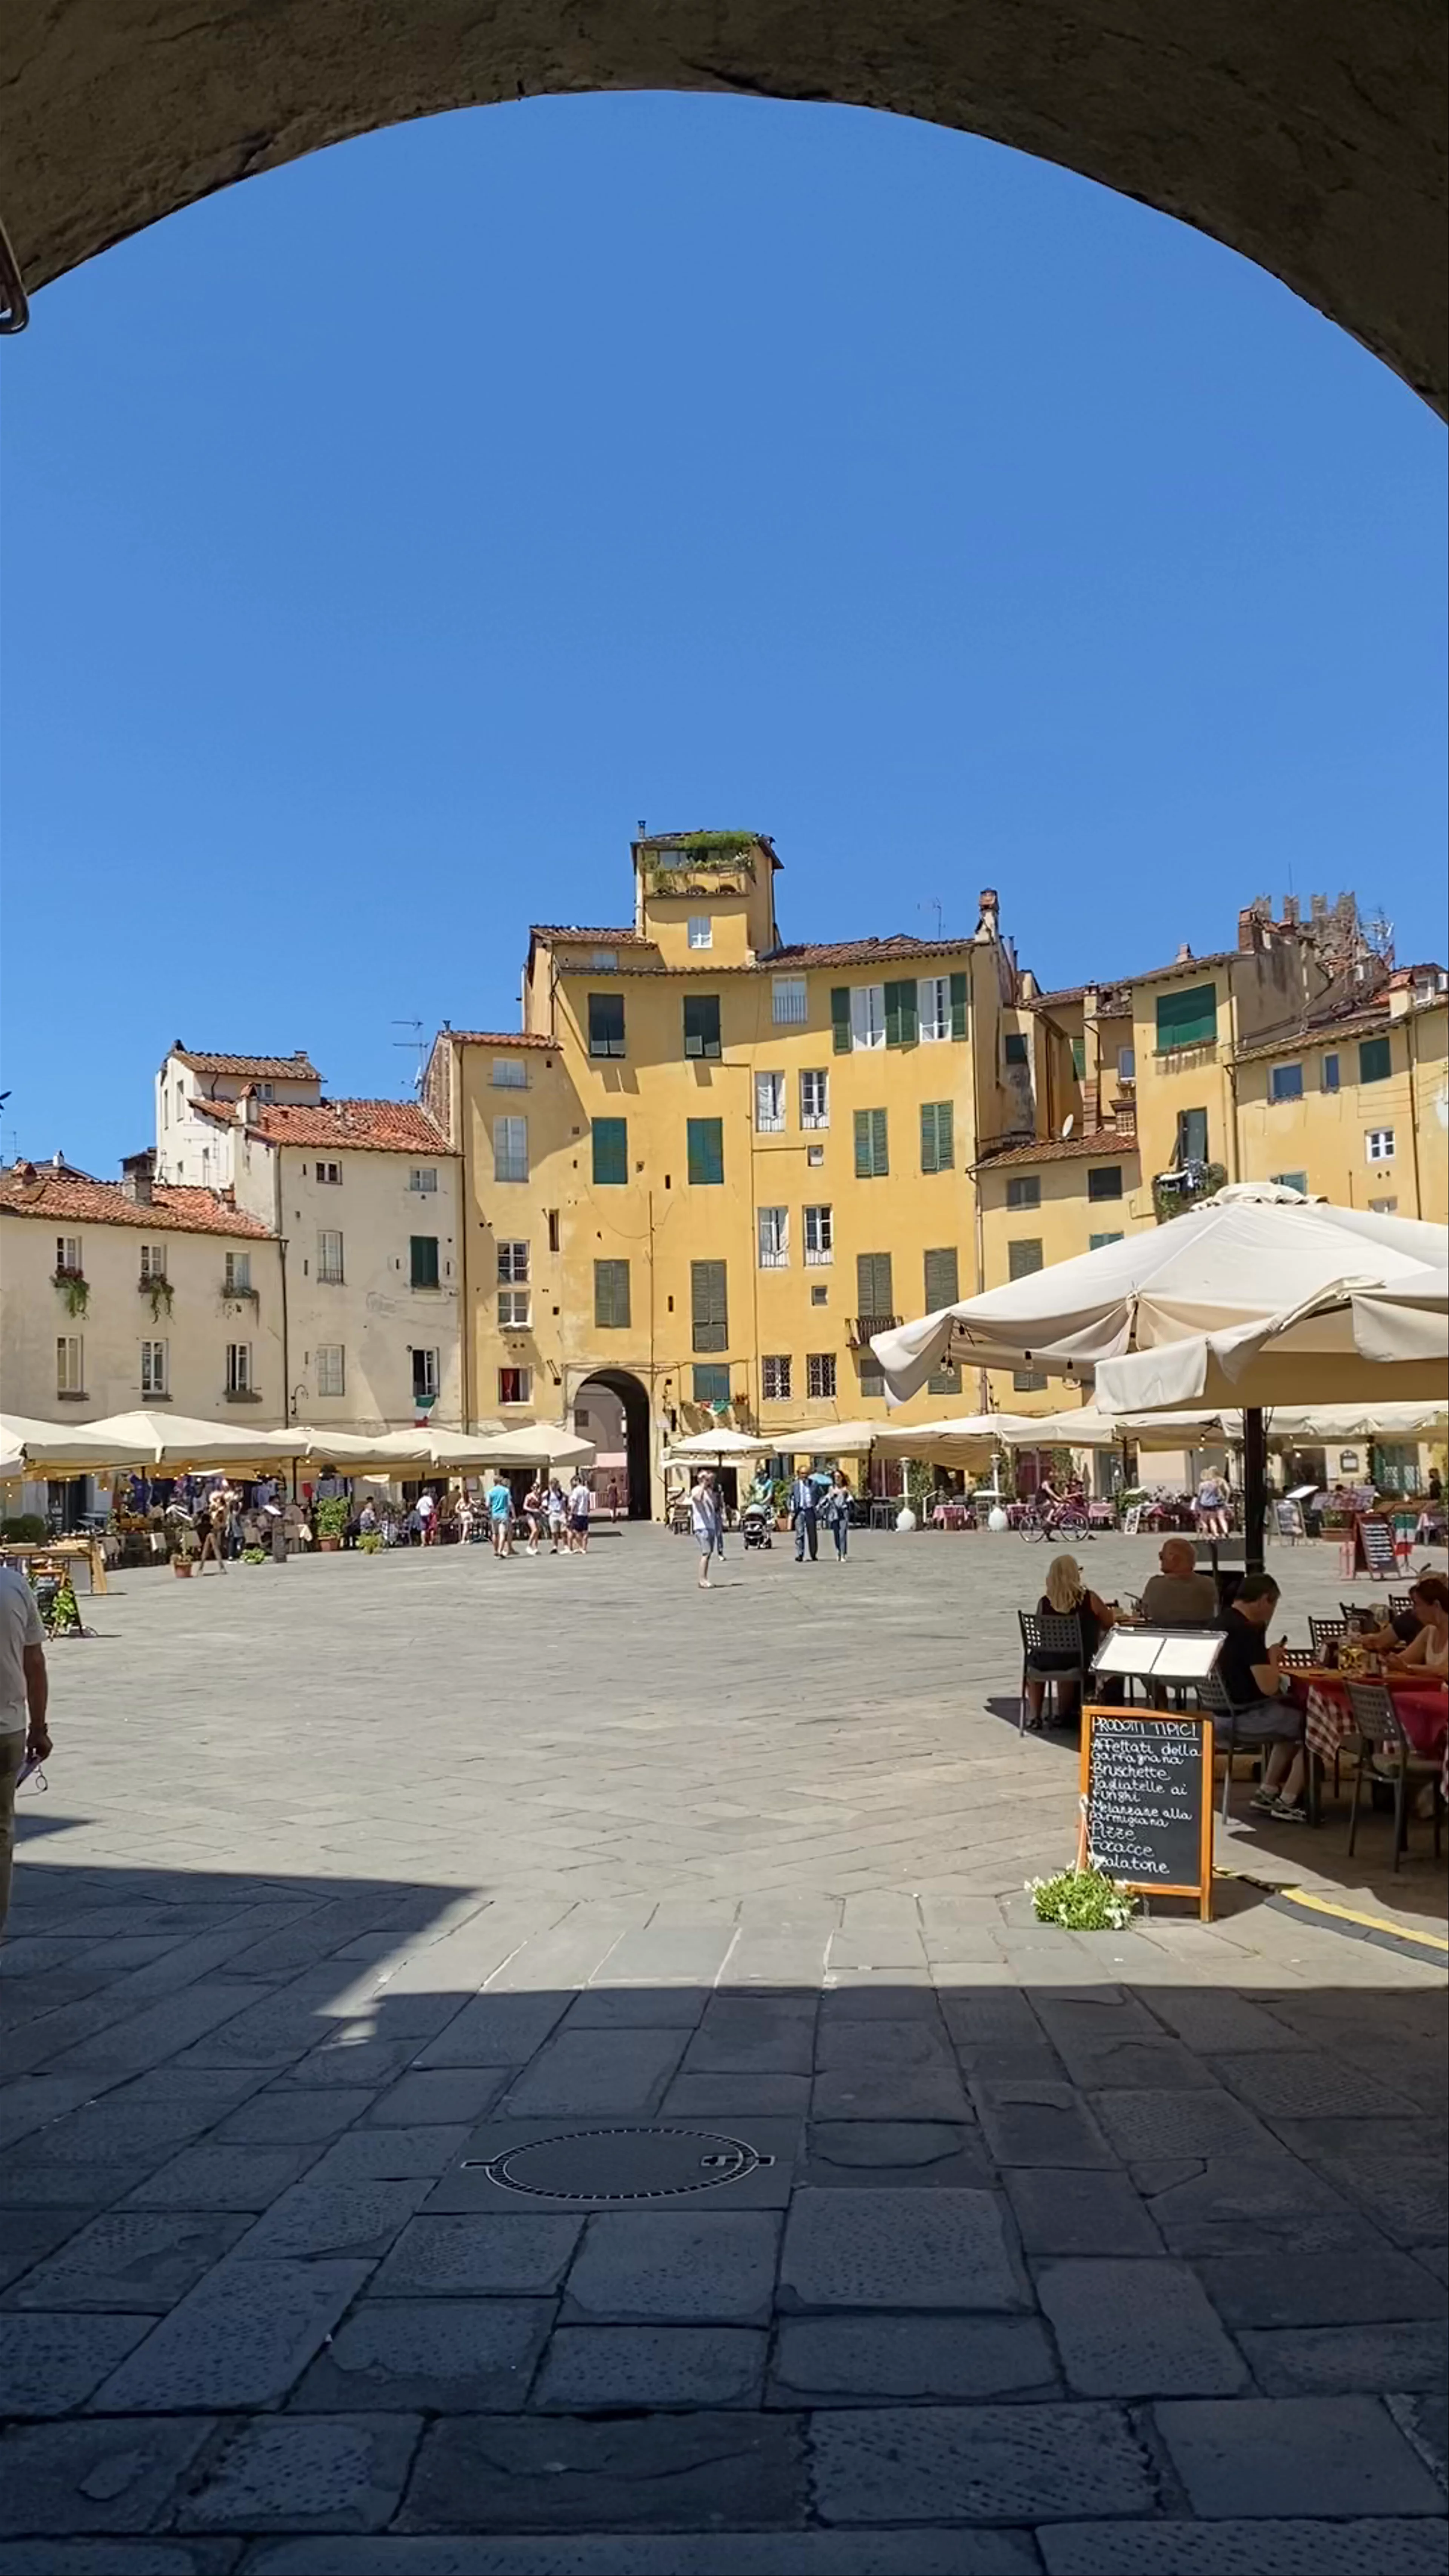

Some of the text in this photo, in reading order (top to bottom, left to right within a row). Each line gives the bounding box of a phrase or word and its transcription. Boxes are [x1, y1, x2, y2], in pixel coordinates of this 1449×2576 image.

[1151, 1722, 1195, 1737] TIPICI
[1161, 1742, 1202, 1756] della
[1171, 1784, 1188, 1795] ai
[1163, 1808, 1192, 1820] alla
